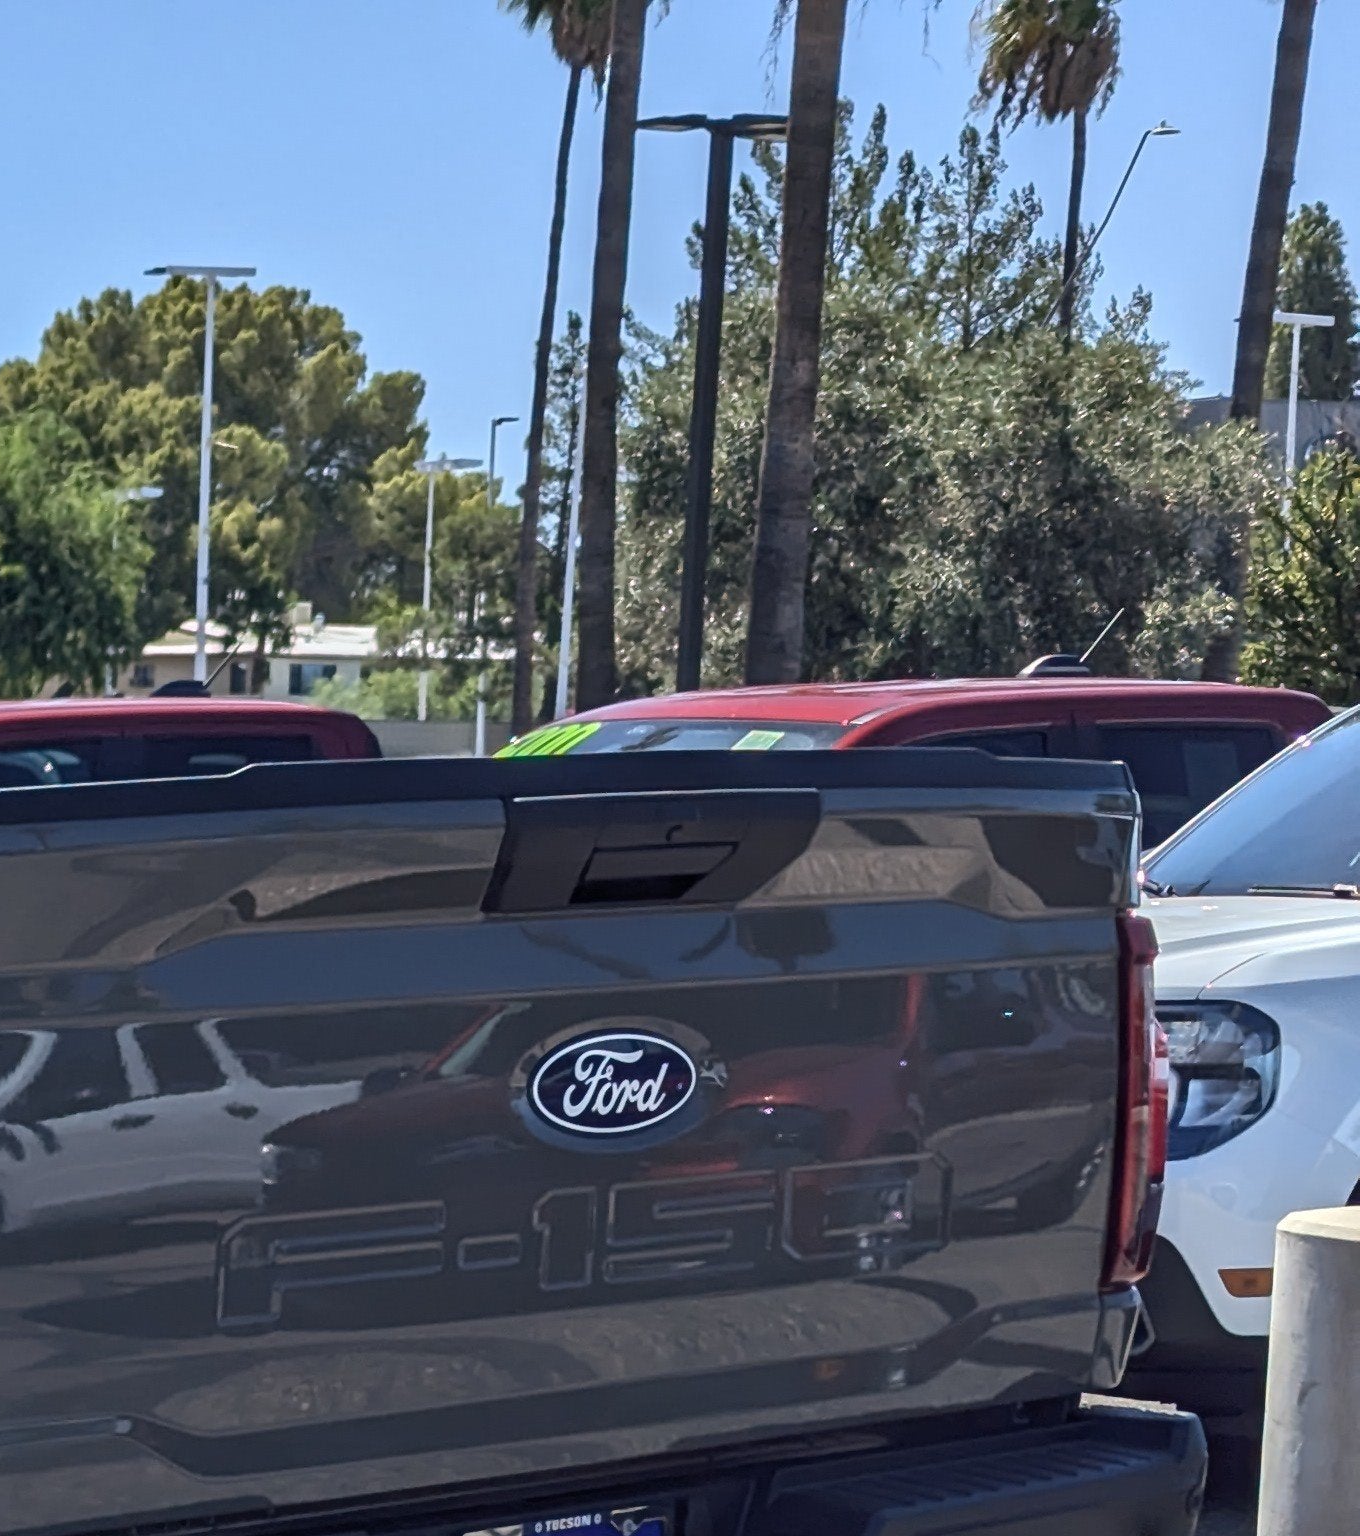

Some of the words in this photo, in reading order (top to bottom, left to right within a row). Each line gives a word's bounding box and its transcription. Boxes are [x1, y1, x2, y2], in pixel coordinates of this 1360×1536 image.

[562, 1049, 669, 1118] Ford
[216, 1152, 952, 1328] F-150
[545, 1514, 592, 1533] TUCSON
